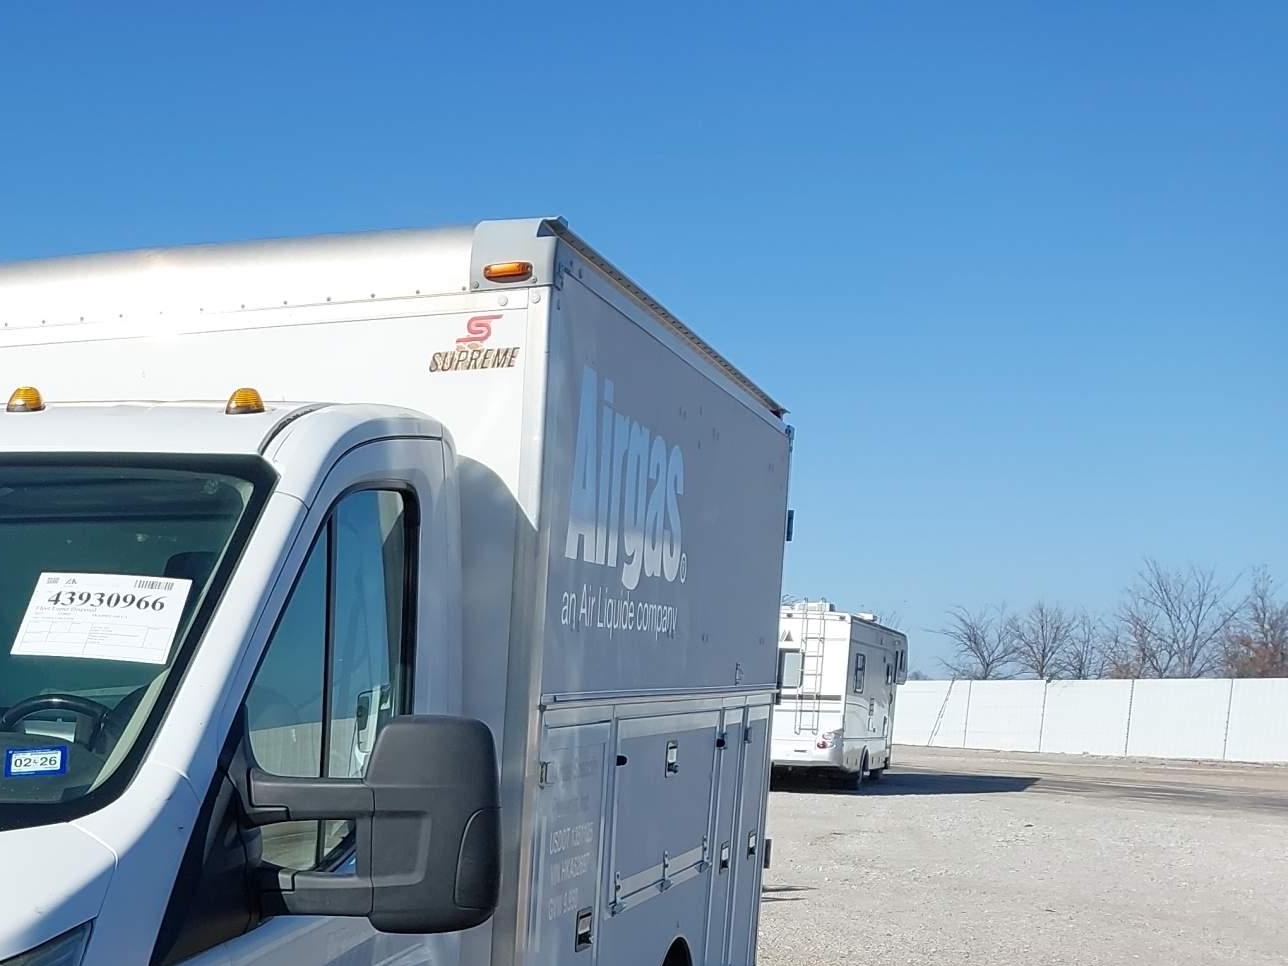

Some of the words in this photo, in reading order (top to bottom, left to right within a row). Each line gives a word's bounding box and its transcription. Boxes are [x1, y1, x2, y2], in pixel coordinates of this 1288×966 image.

[429, 346, 521, 373] SUPREME
[564, 364, 685, 591] Airgas
[47, 590, 169, 612] 43930966
[561, 591, 577, 630] an
[579, 583, 596, 627] Air
[597, 586, 635, 641] Liquide
[637, 601, 678, 641] company
[14, 756, 57, 768] 02-26
